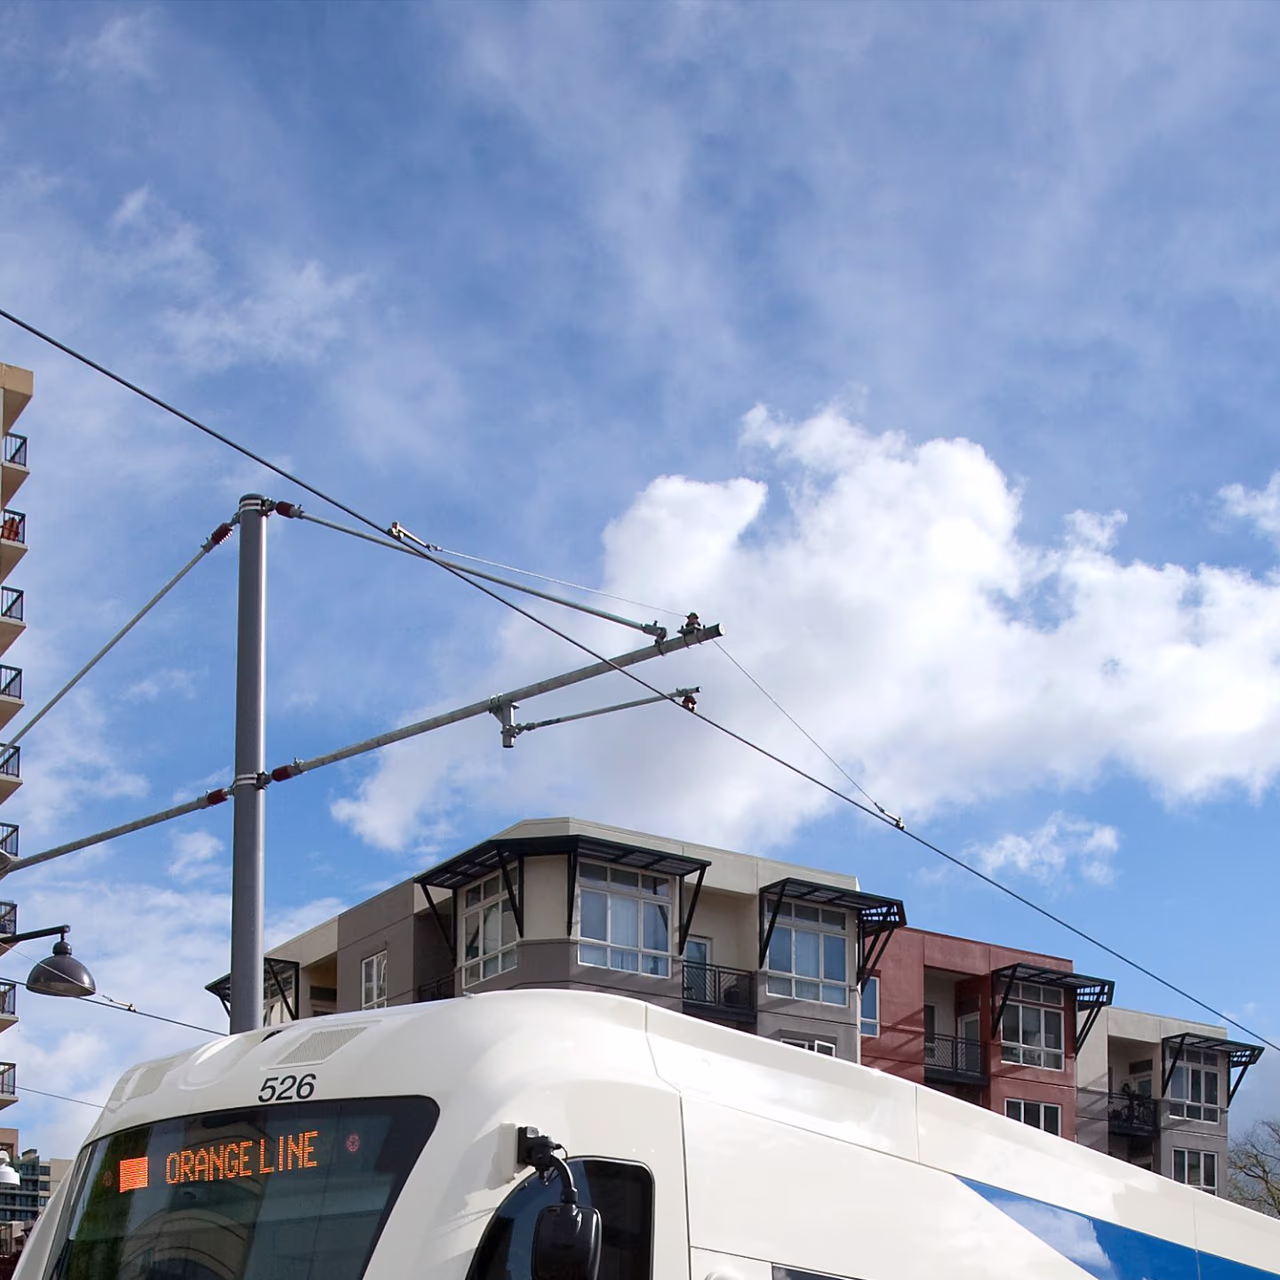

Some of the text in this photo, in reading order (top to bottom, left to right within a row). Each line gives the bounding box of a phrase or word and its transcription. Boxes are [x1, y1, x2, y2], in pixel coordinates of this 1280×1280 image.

[258, 1073, 317, 1103] 526
[166, 1130, 319, 1185] ORANGE LINE
